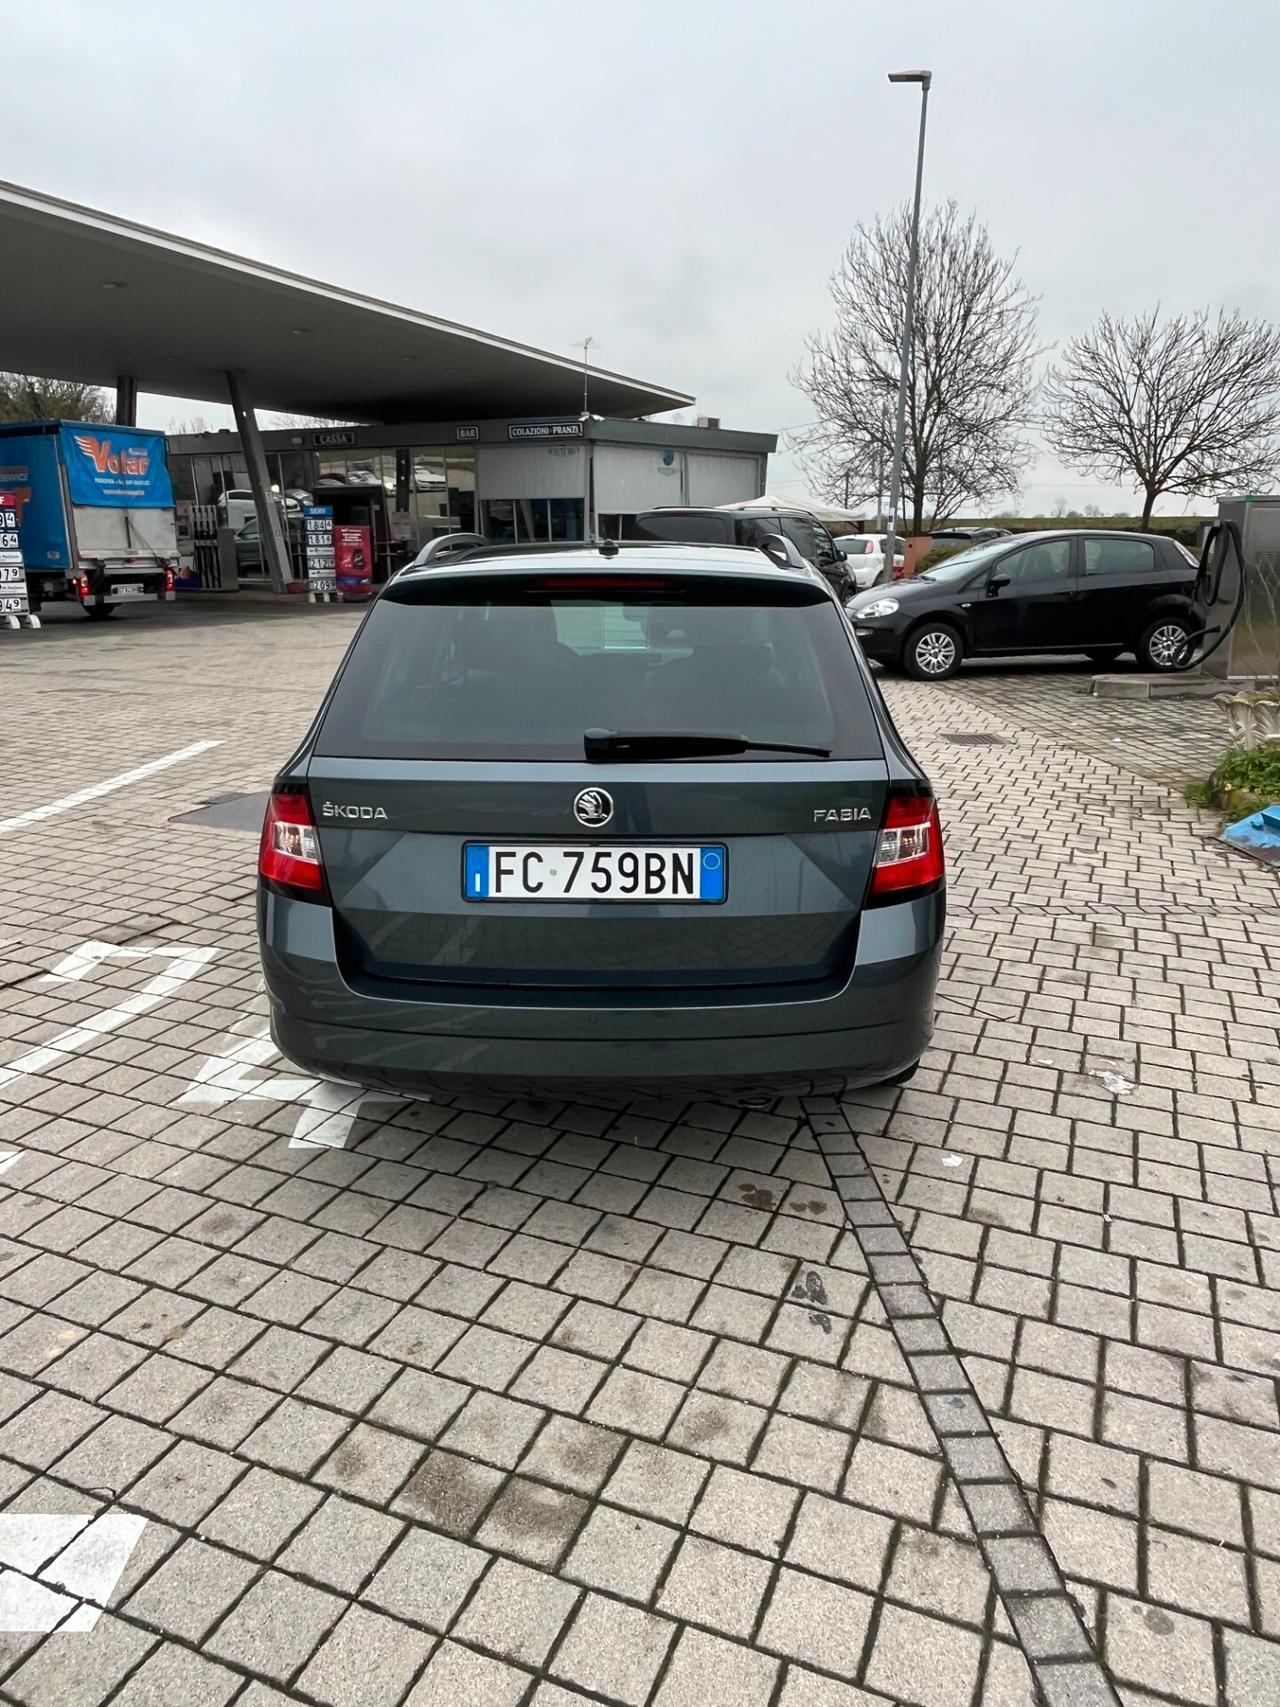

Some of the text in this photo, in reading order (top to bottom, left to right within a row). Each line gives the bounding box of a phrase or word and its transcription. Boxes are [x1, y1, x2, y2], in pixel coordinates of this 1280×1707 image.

[460, 429, 475, 438] BAR
[512, 425, 579, 436] COLAZIONI PRANZI
[322, 801, 388, 820] ŠKODA
[813, 807, 872, 823] FABIA
